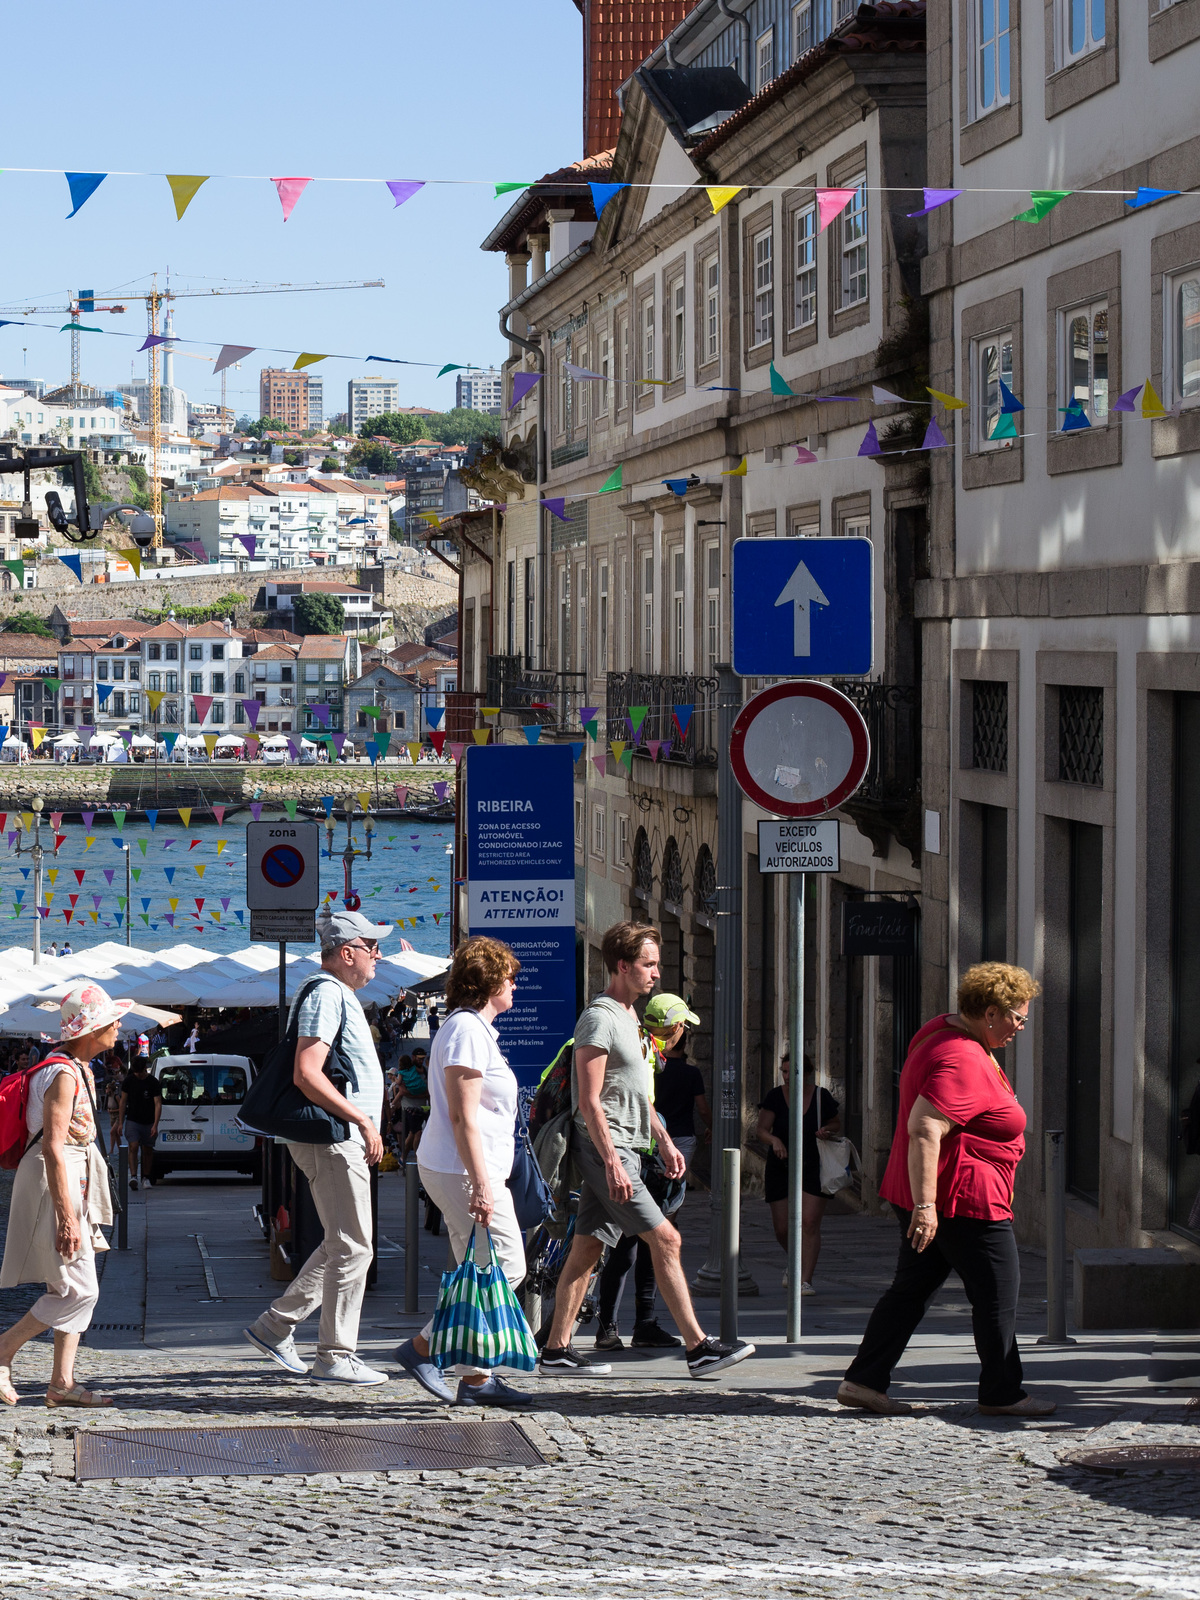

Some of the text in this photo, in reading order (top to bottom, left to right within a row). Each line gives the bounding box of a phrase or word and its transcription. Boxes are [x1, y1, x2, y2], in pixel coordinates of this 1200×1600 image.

[17, 665, 56, 674] KOPKE
[477, 800, 534, 813] RIBEIRA
[478, 822, 541, 831] ZONA DE ACESSO
[779, 825, 817, 837] EXCETO
[268, 829, 297, 838] zona
[478, 831, 524, 840] AUTOMÓVEL
[478, 841, 539, 849] CONDICIONADO
[775, 839, 822, 853] VEÍCULOS
[766, 856, 834, 868] AUTORIZADOS
[480, 887, 564, 904] ATENÇÃO!
[484, 908, 559, 919] ATTENTION!
[510, 940, 560, 949] OBRIGATÓRIO
[518, 1038, 544, 1046] Máxima
